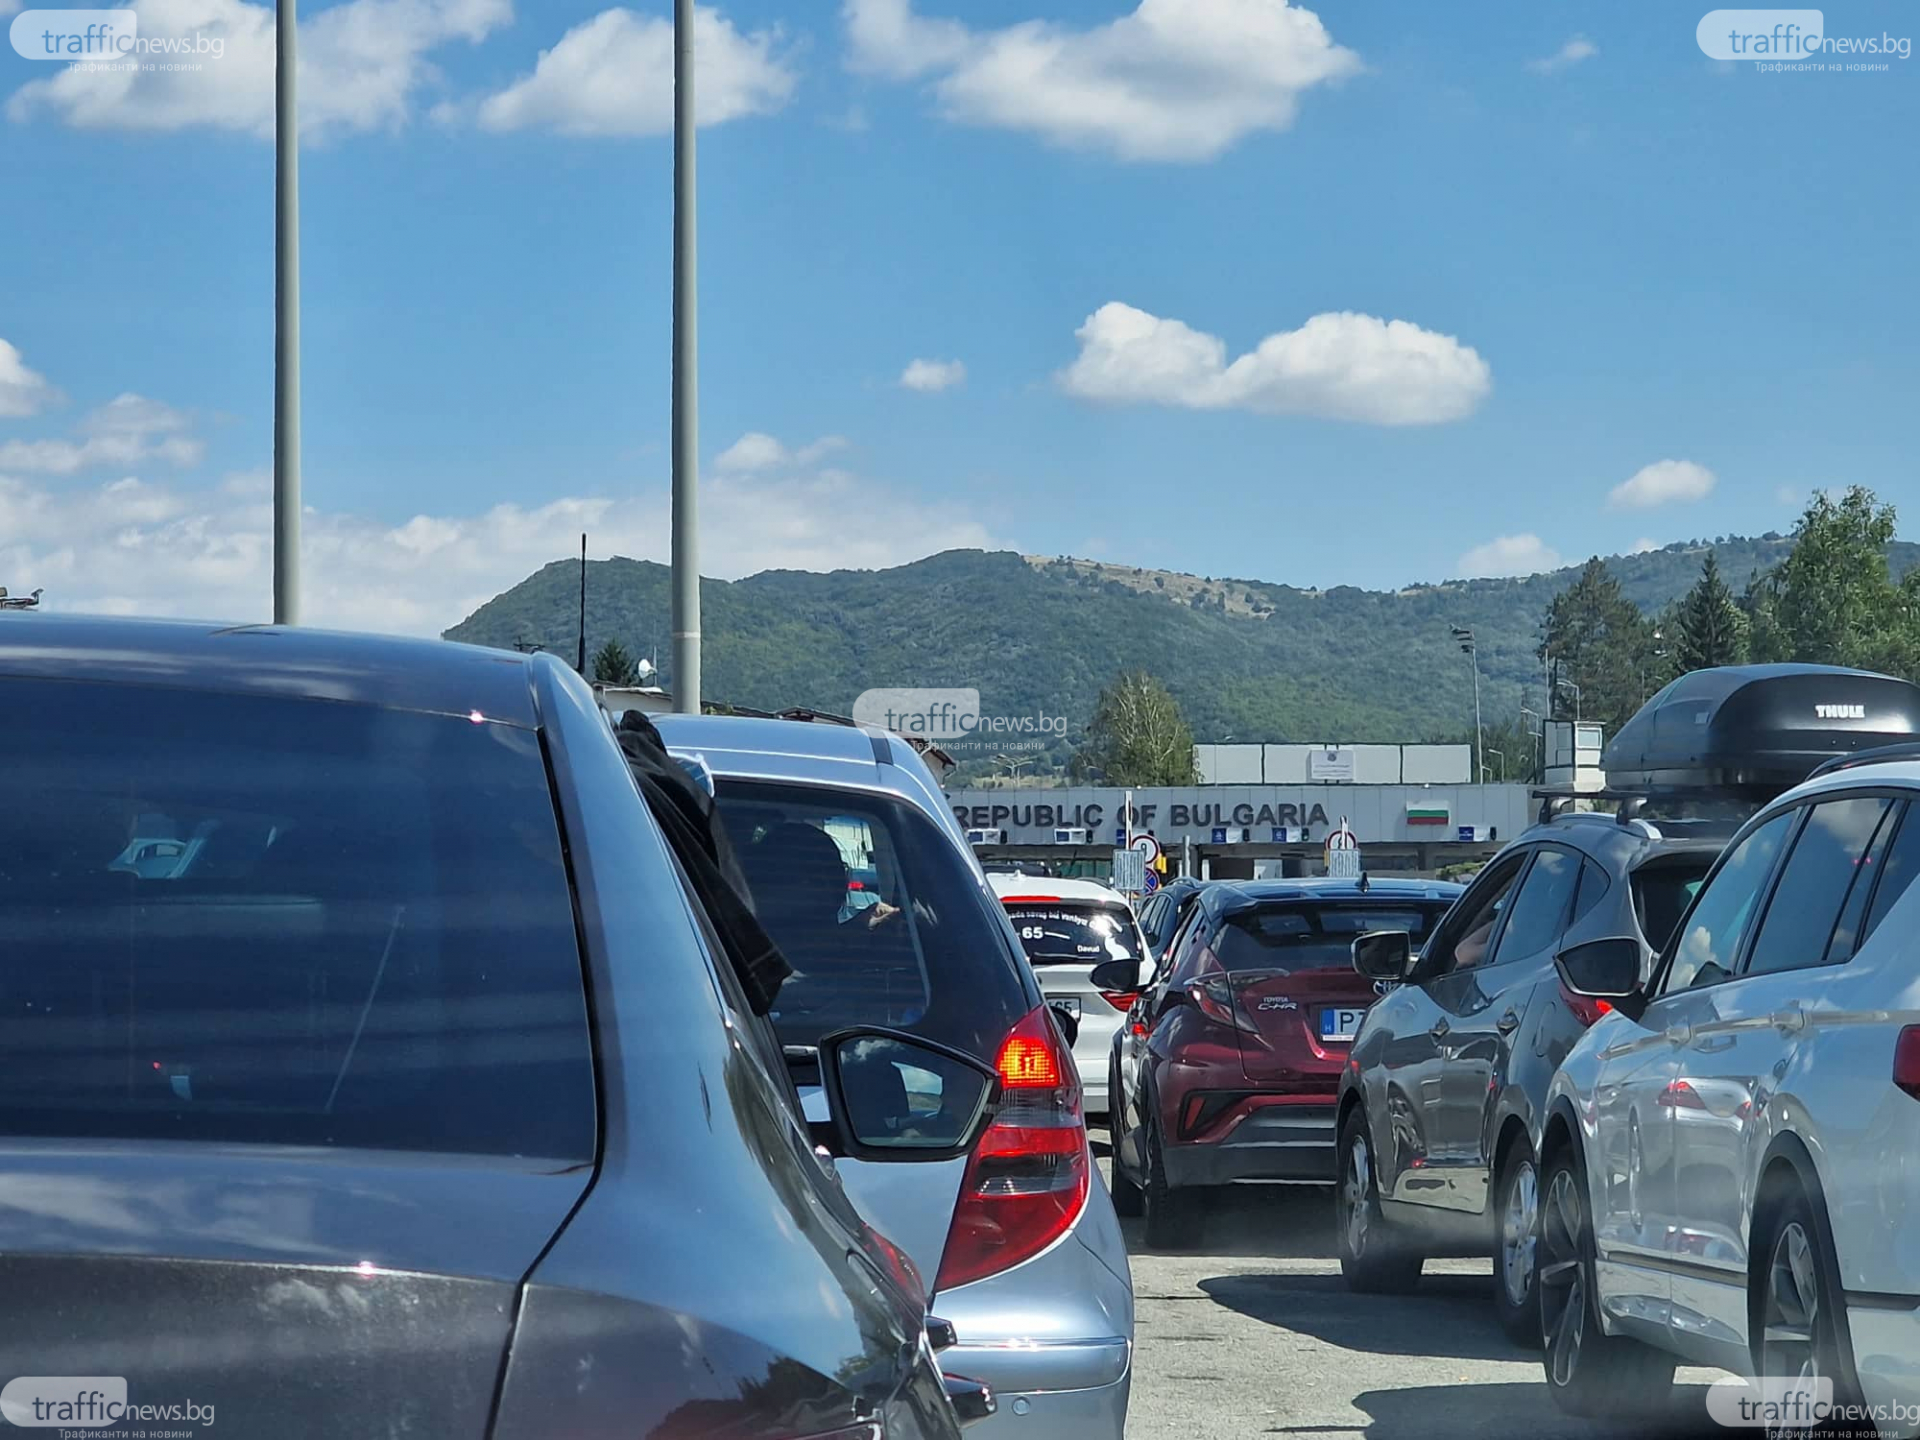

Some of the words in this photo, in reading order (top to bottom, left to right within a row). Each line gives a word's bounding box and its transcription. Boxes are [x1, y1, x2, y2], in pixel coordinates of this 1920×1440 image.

[1815, 705, 1865, 718] THULE
[953, 804, 1103, 828] REPUBLIC
[1117, 804, 1157, 827] OF
[1171, 803, 1329, 827] BULGARIA
[1022, 926, 1044, 939] 65
